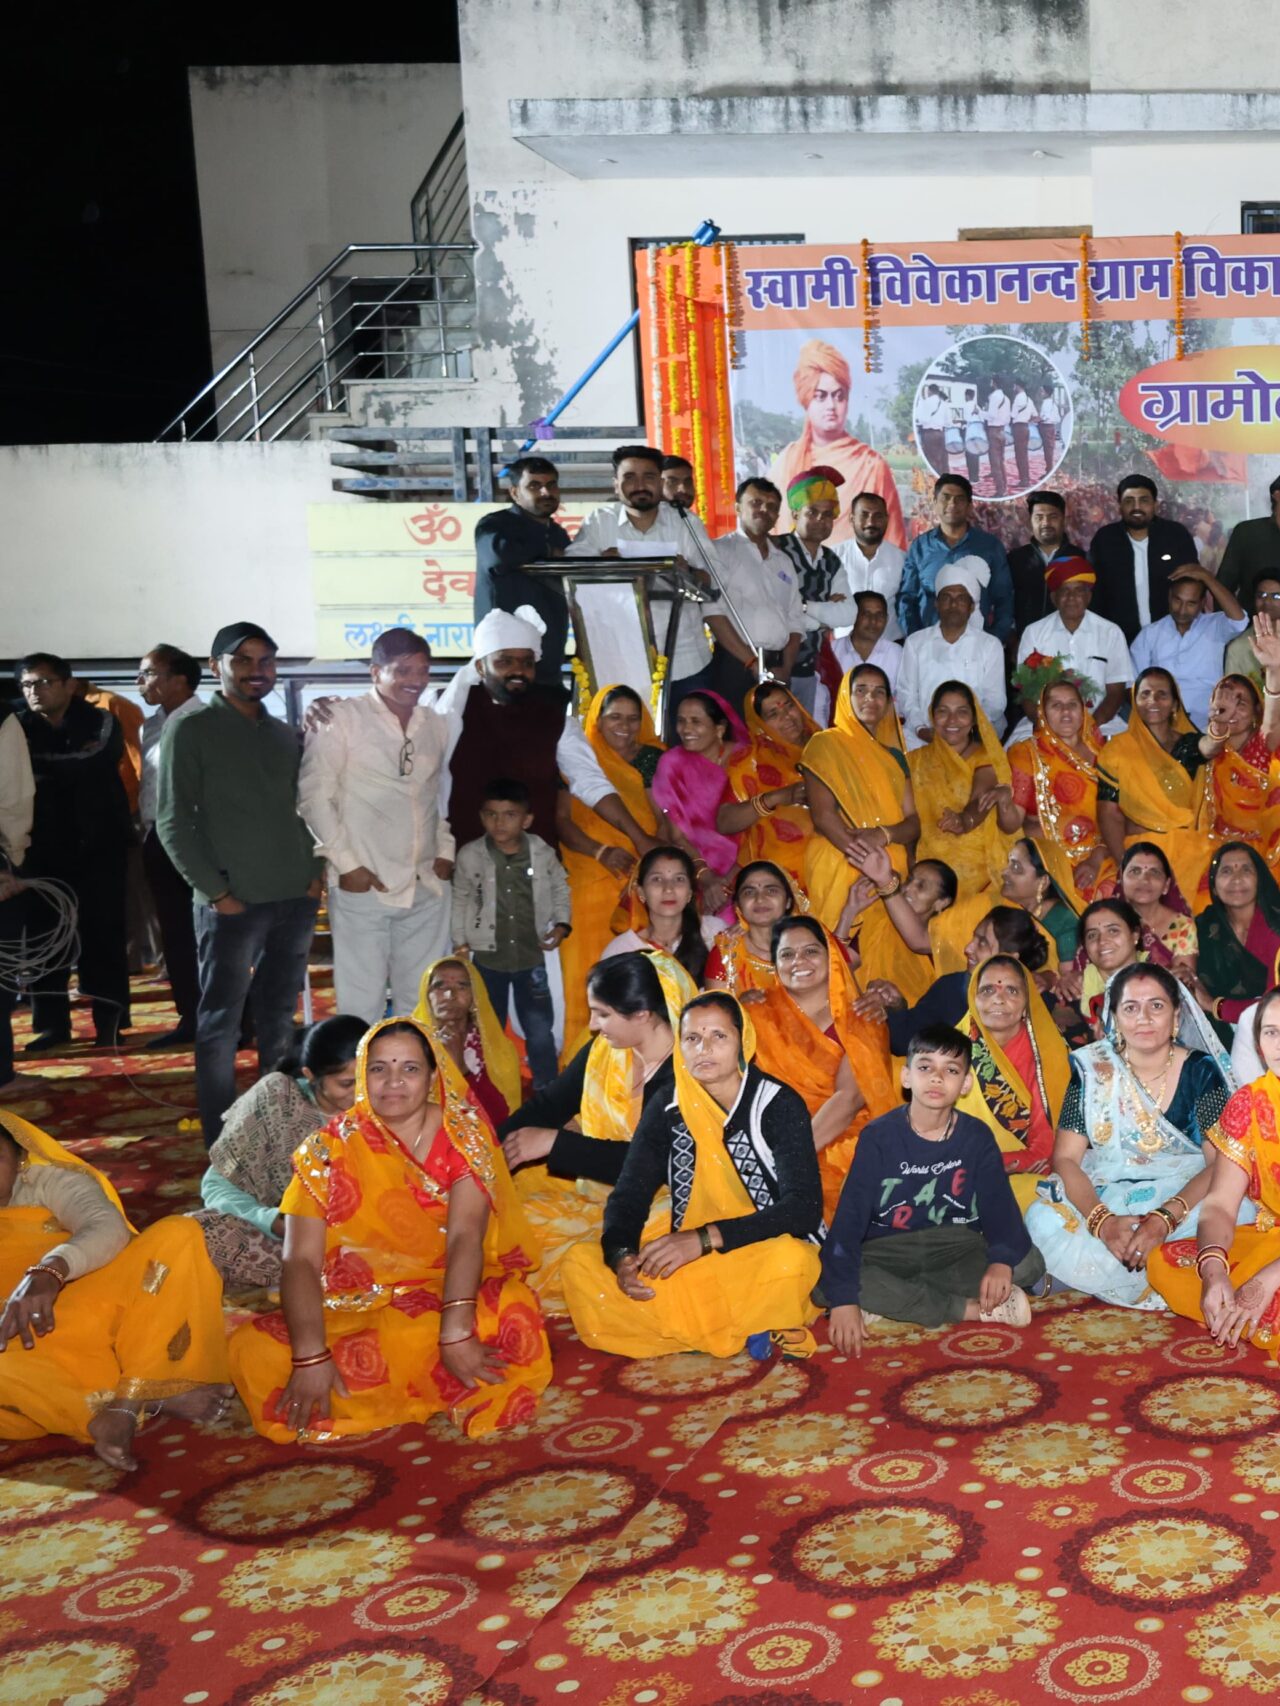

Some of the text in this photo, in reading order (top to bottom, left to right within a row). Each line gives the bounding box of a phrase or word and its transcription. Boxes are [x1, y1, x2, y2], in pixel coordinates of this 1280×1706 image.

[745, 256, 858, 310] स्वामी
[869, 253, 1080, 306] विवेकानन्द
[1088, 256, 1174, 302] ग्राम
[422, 559, 477, 604] देव
[900, 1161, 930, 1175] World
